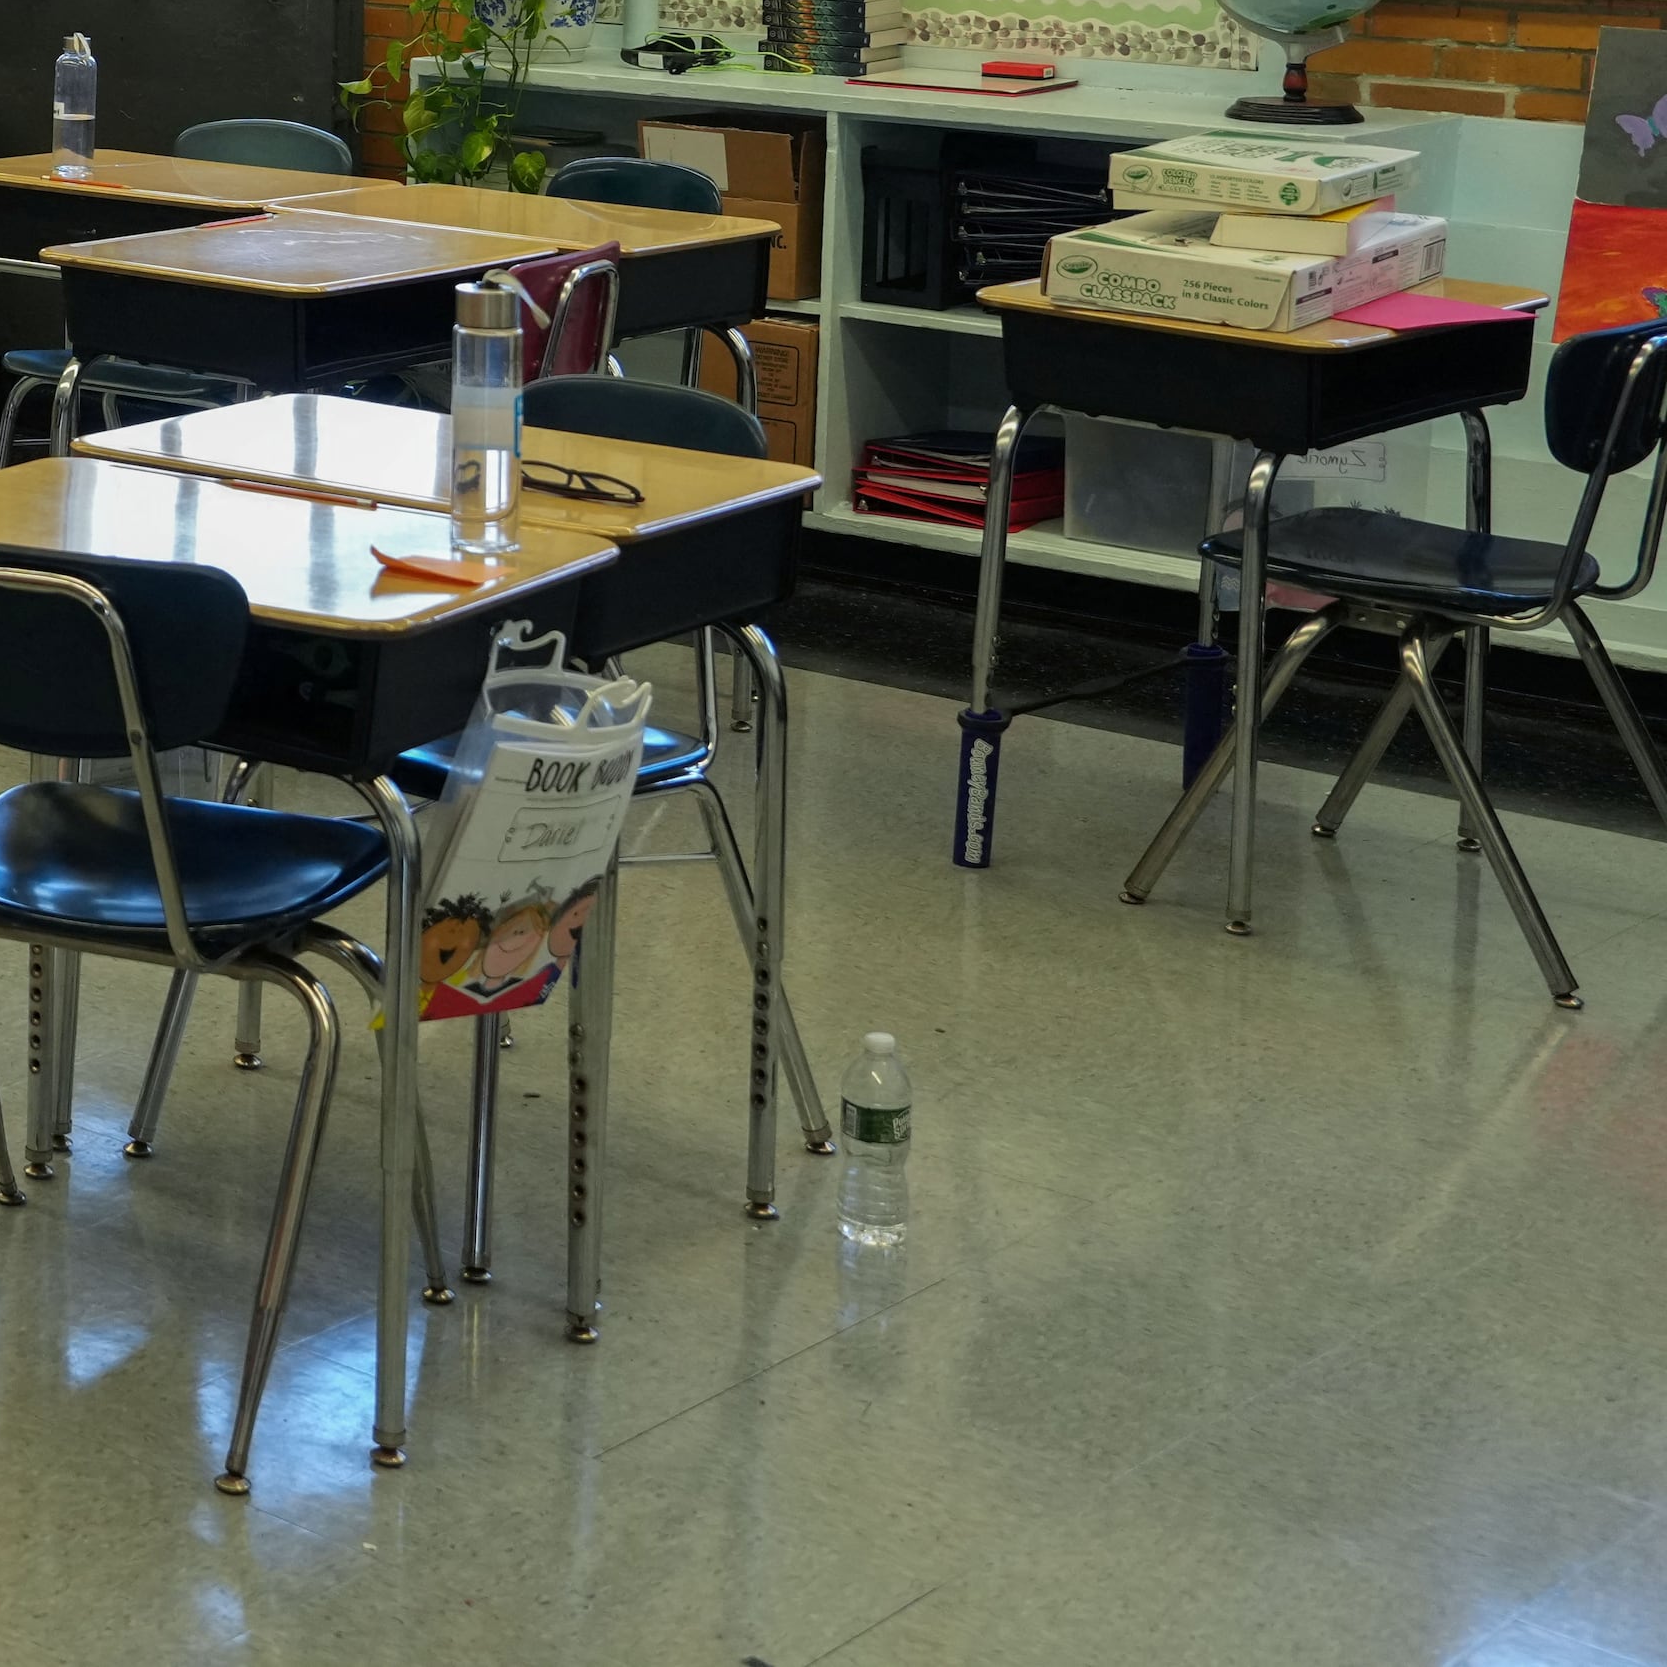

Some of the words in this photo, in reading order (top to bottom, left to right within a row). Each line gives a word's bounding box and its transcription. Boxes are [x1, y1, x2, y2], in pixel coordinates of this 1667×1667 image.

[1162, 168, 1198, 180] COLORED
[768, 235, 787, 249] NC.
[1097, 272, 1162, 294] COMBO
[1183, 279, 1201, 290] 256
[1203, 281, 1234, 294] Pieces
[1079, 283, 1177, 311] CLASSPACK
[1182, 290, 1191, 299] in
[1193, 291, 1200, 300] 8
[1202, 292, 1235, 306] Classic
[1237, 297, 1269, 311] Colors
[525, 757, 591, 794] BOOK
